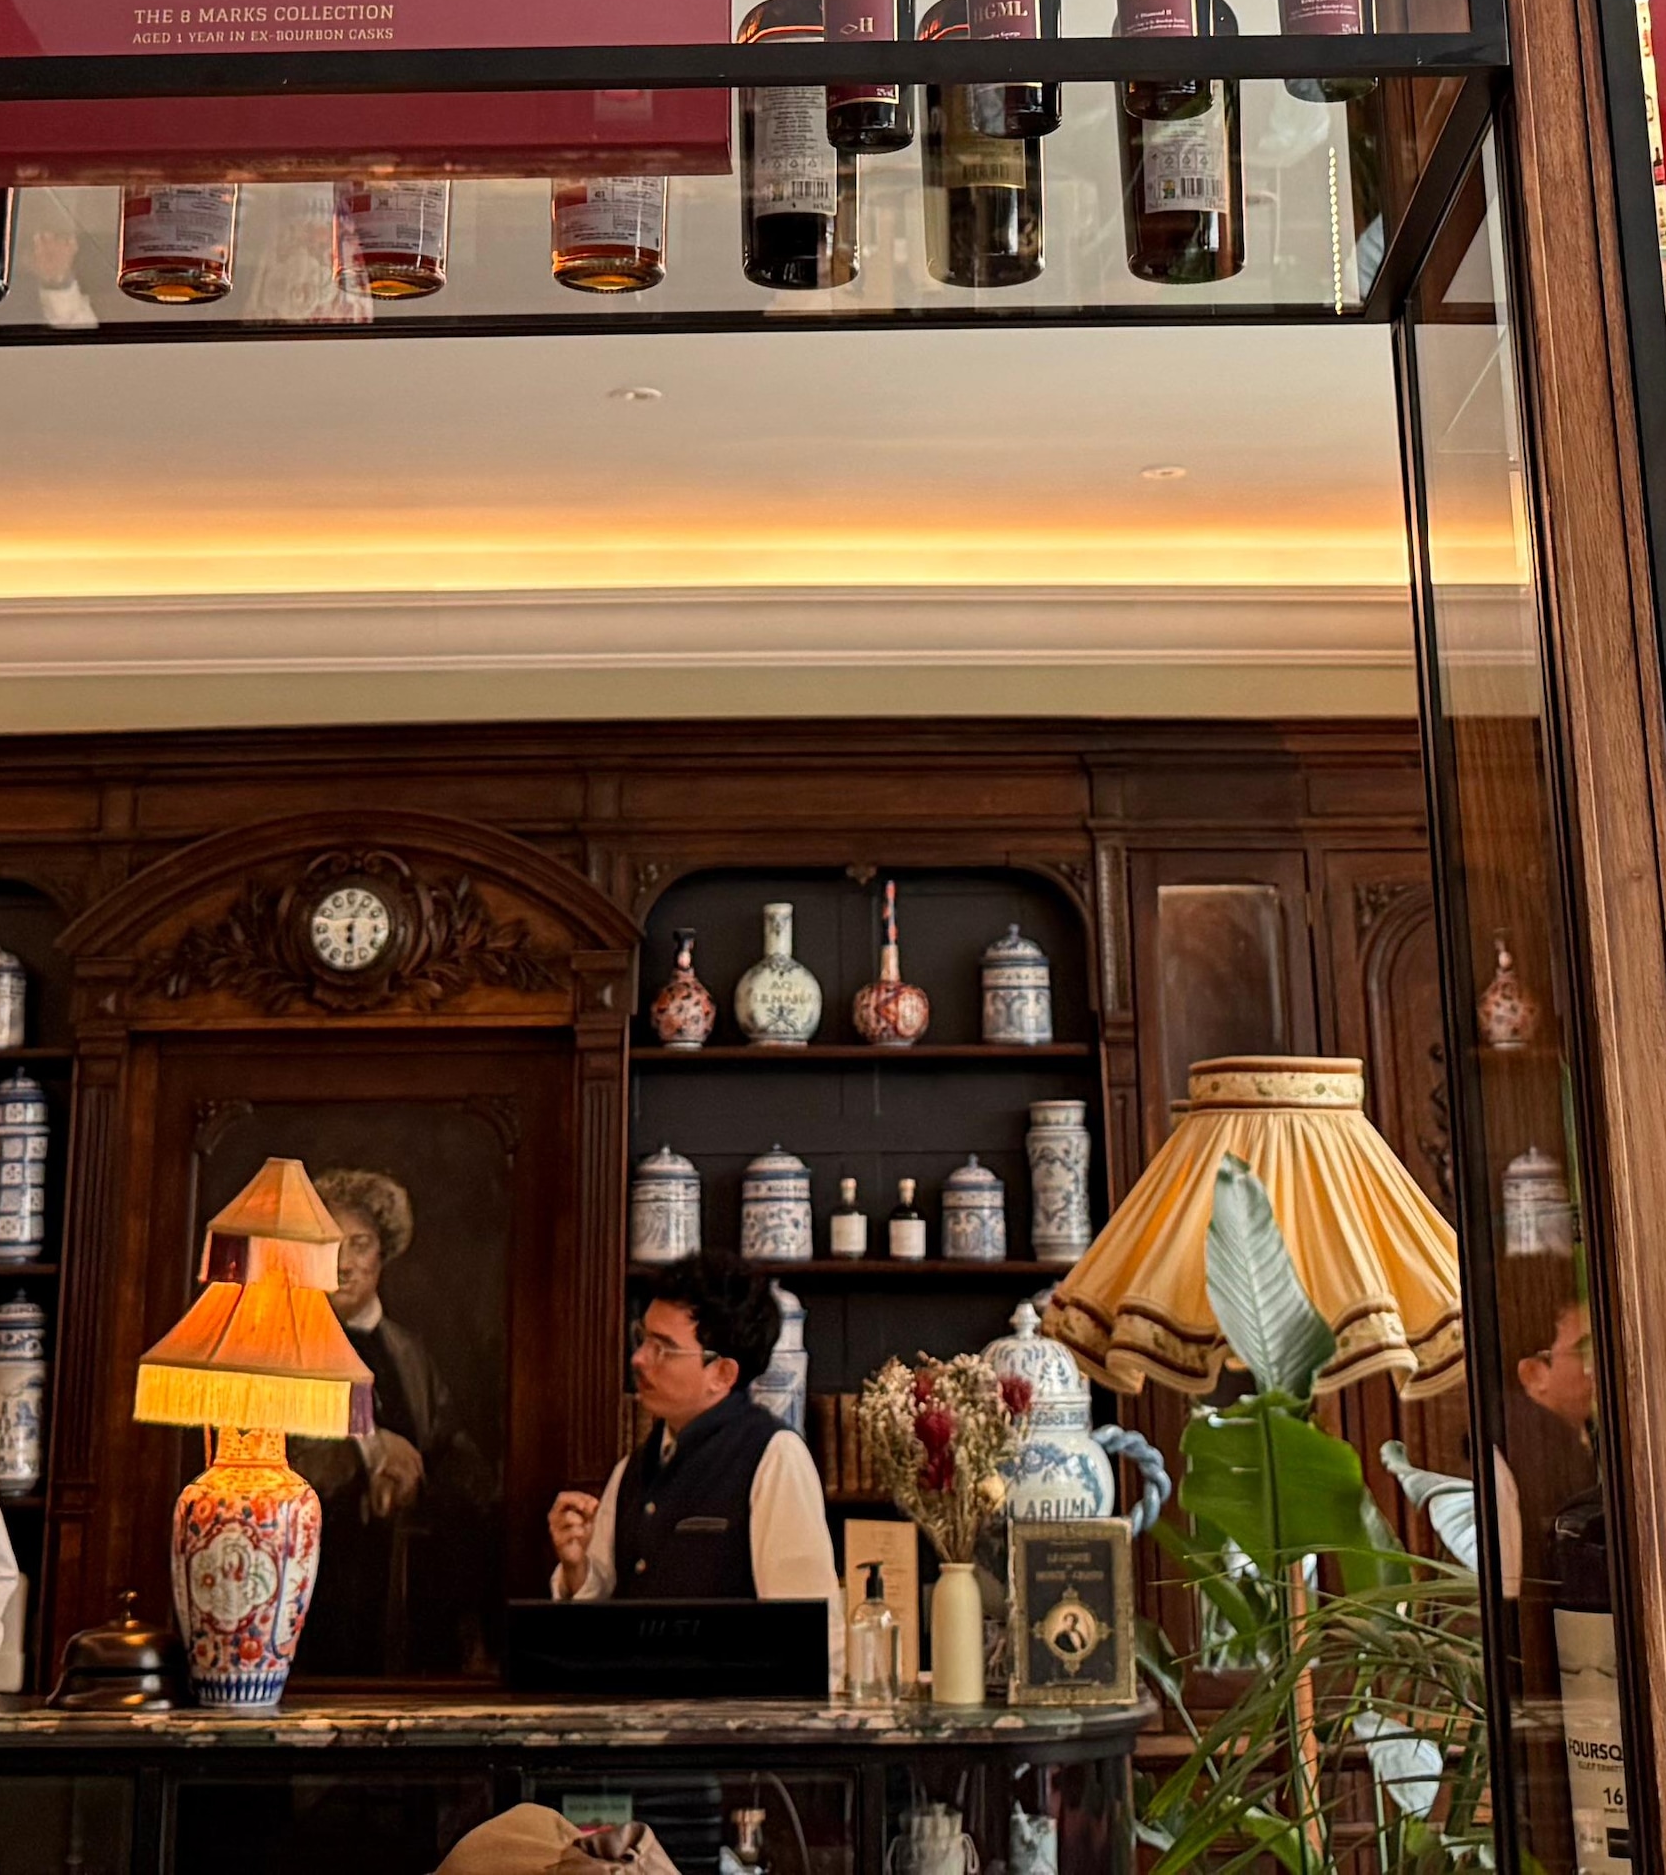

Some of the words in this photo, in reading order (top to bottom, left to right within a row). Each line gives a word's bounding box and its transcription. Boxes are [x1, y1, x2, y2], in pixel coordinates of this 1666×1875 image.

[134, 9, 173, 24] THE
[180, 9, 191, 24] 8
[198, 7, 268, 23] MARKS
[274, 4, 395, 22] COLLECTION
[132, 32, 171, 44] AGED
[176, 32, 183, 44] 1
[188, 31, 225, 44] YEAR
[229, 30, 245, 43] IN
[250, 28, 344, 43] EX-BOURBON
[348, 27, 394, 41] CASKS
[1603, 1787, 1624, 1806] 16
